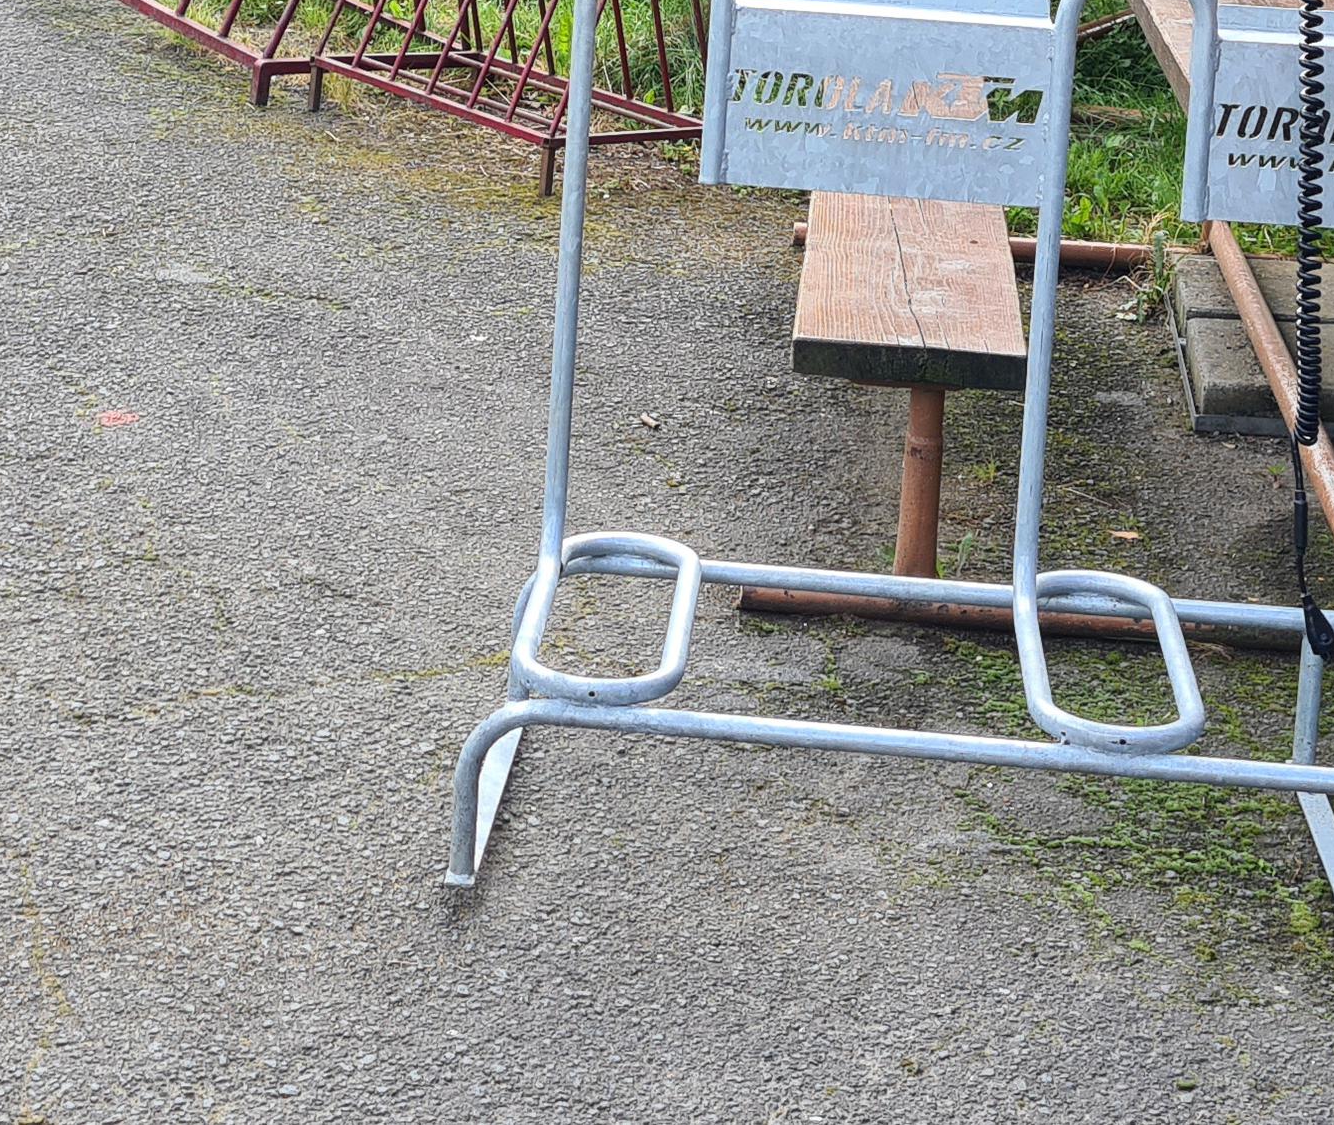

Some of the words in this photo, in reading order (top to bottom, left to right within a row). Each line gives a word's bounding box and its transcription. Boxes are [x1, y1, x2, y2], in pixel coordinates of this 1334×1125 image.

[732, 68, 892, 114] TOROLA
[897, 72, 1044, 125] KTM
[745, 117, 1026, 150] www.ktm-fm.cz
